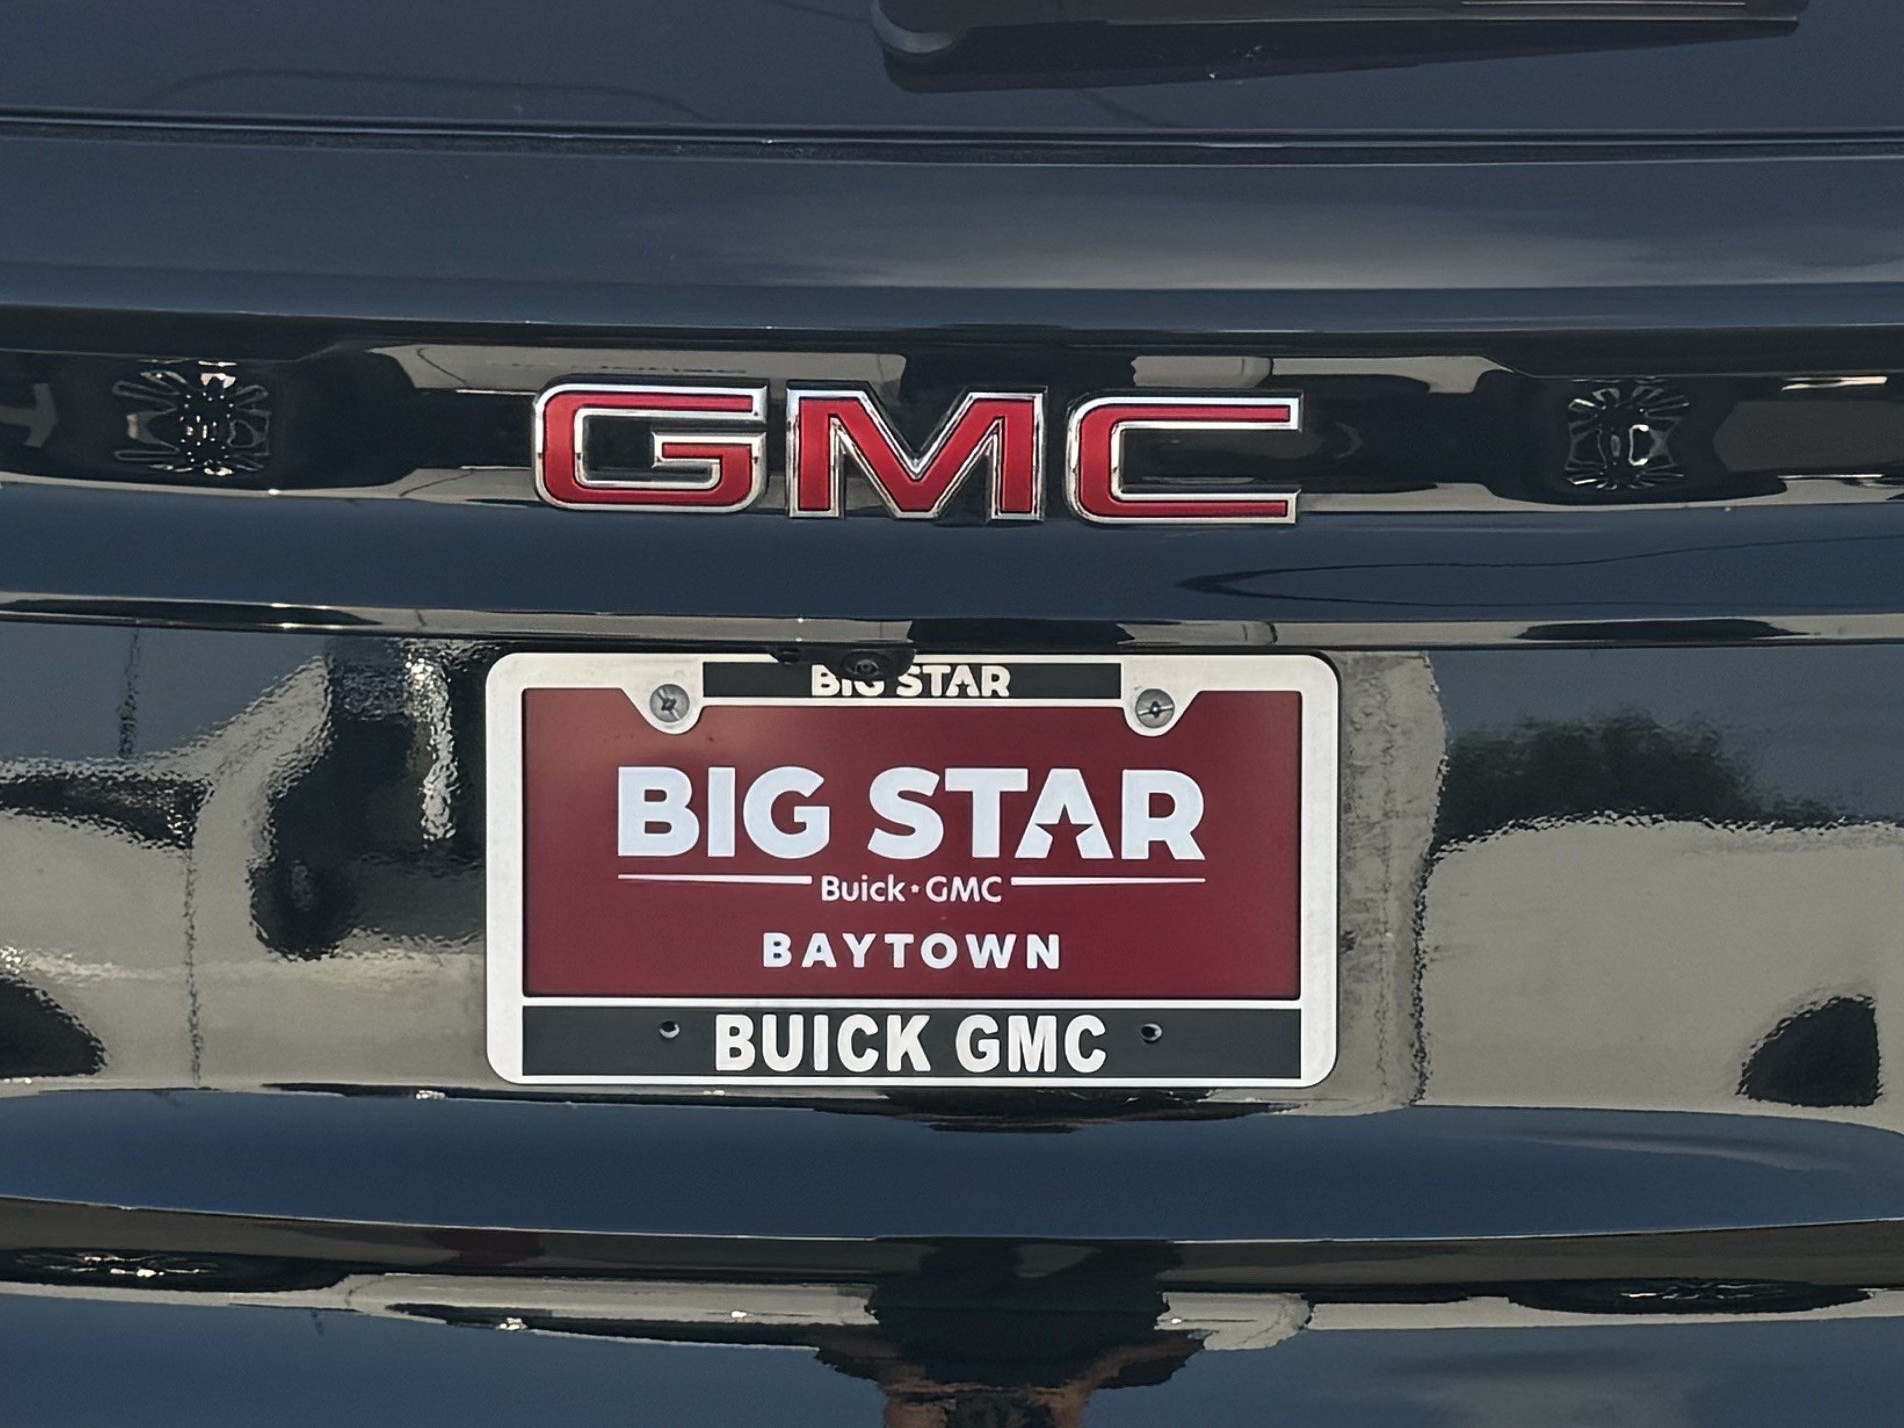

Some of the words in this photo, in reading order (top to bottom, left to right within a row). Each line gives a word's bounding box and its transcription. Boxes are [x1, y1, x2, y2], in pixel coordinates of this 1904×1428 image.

[534, 381, 1302, 525] GMC
[896, 664, 1011, 697] STAR
[618, 766, 831, 859] BIG
[868, 766, 1206, 861] STAR
[820, 874, 906, 903] Buick
[925, 876, 1003, 904] GMC
[763, 932, 1062, 970] BAYTOWN
[715, 1014, 931, 1072] BUICK
[955, 1014, 1108, 1073] GMC
